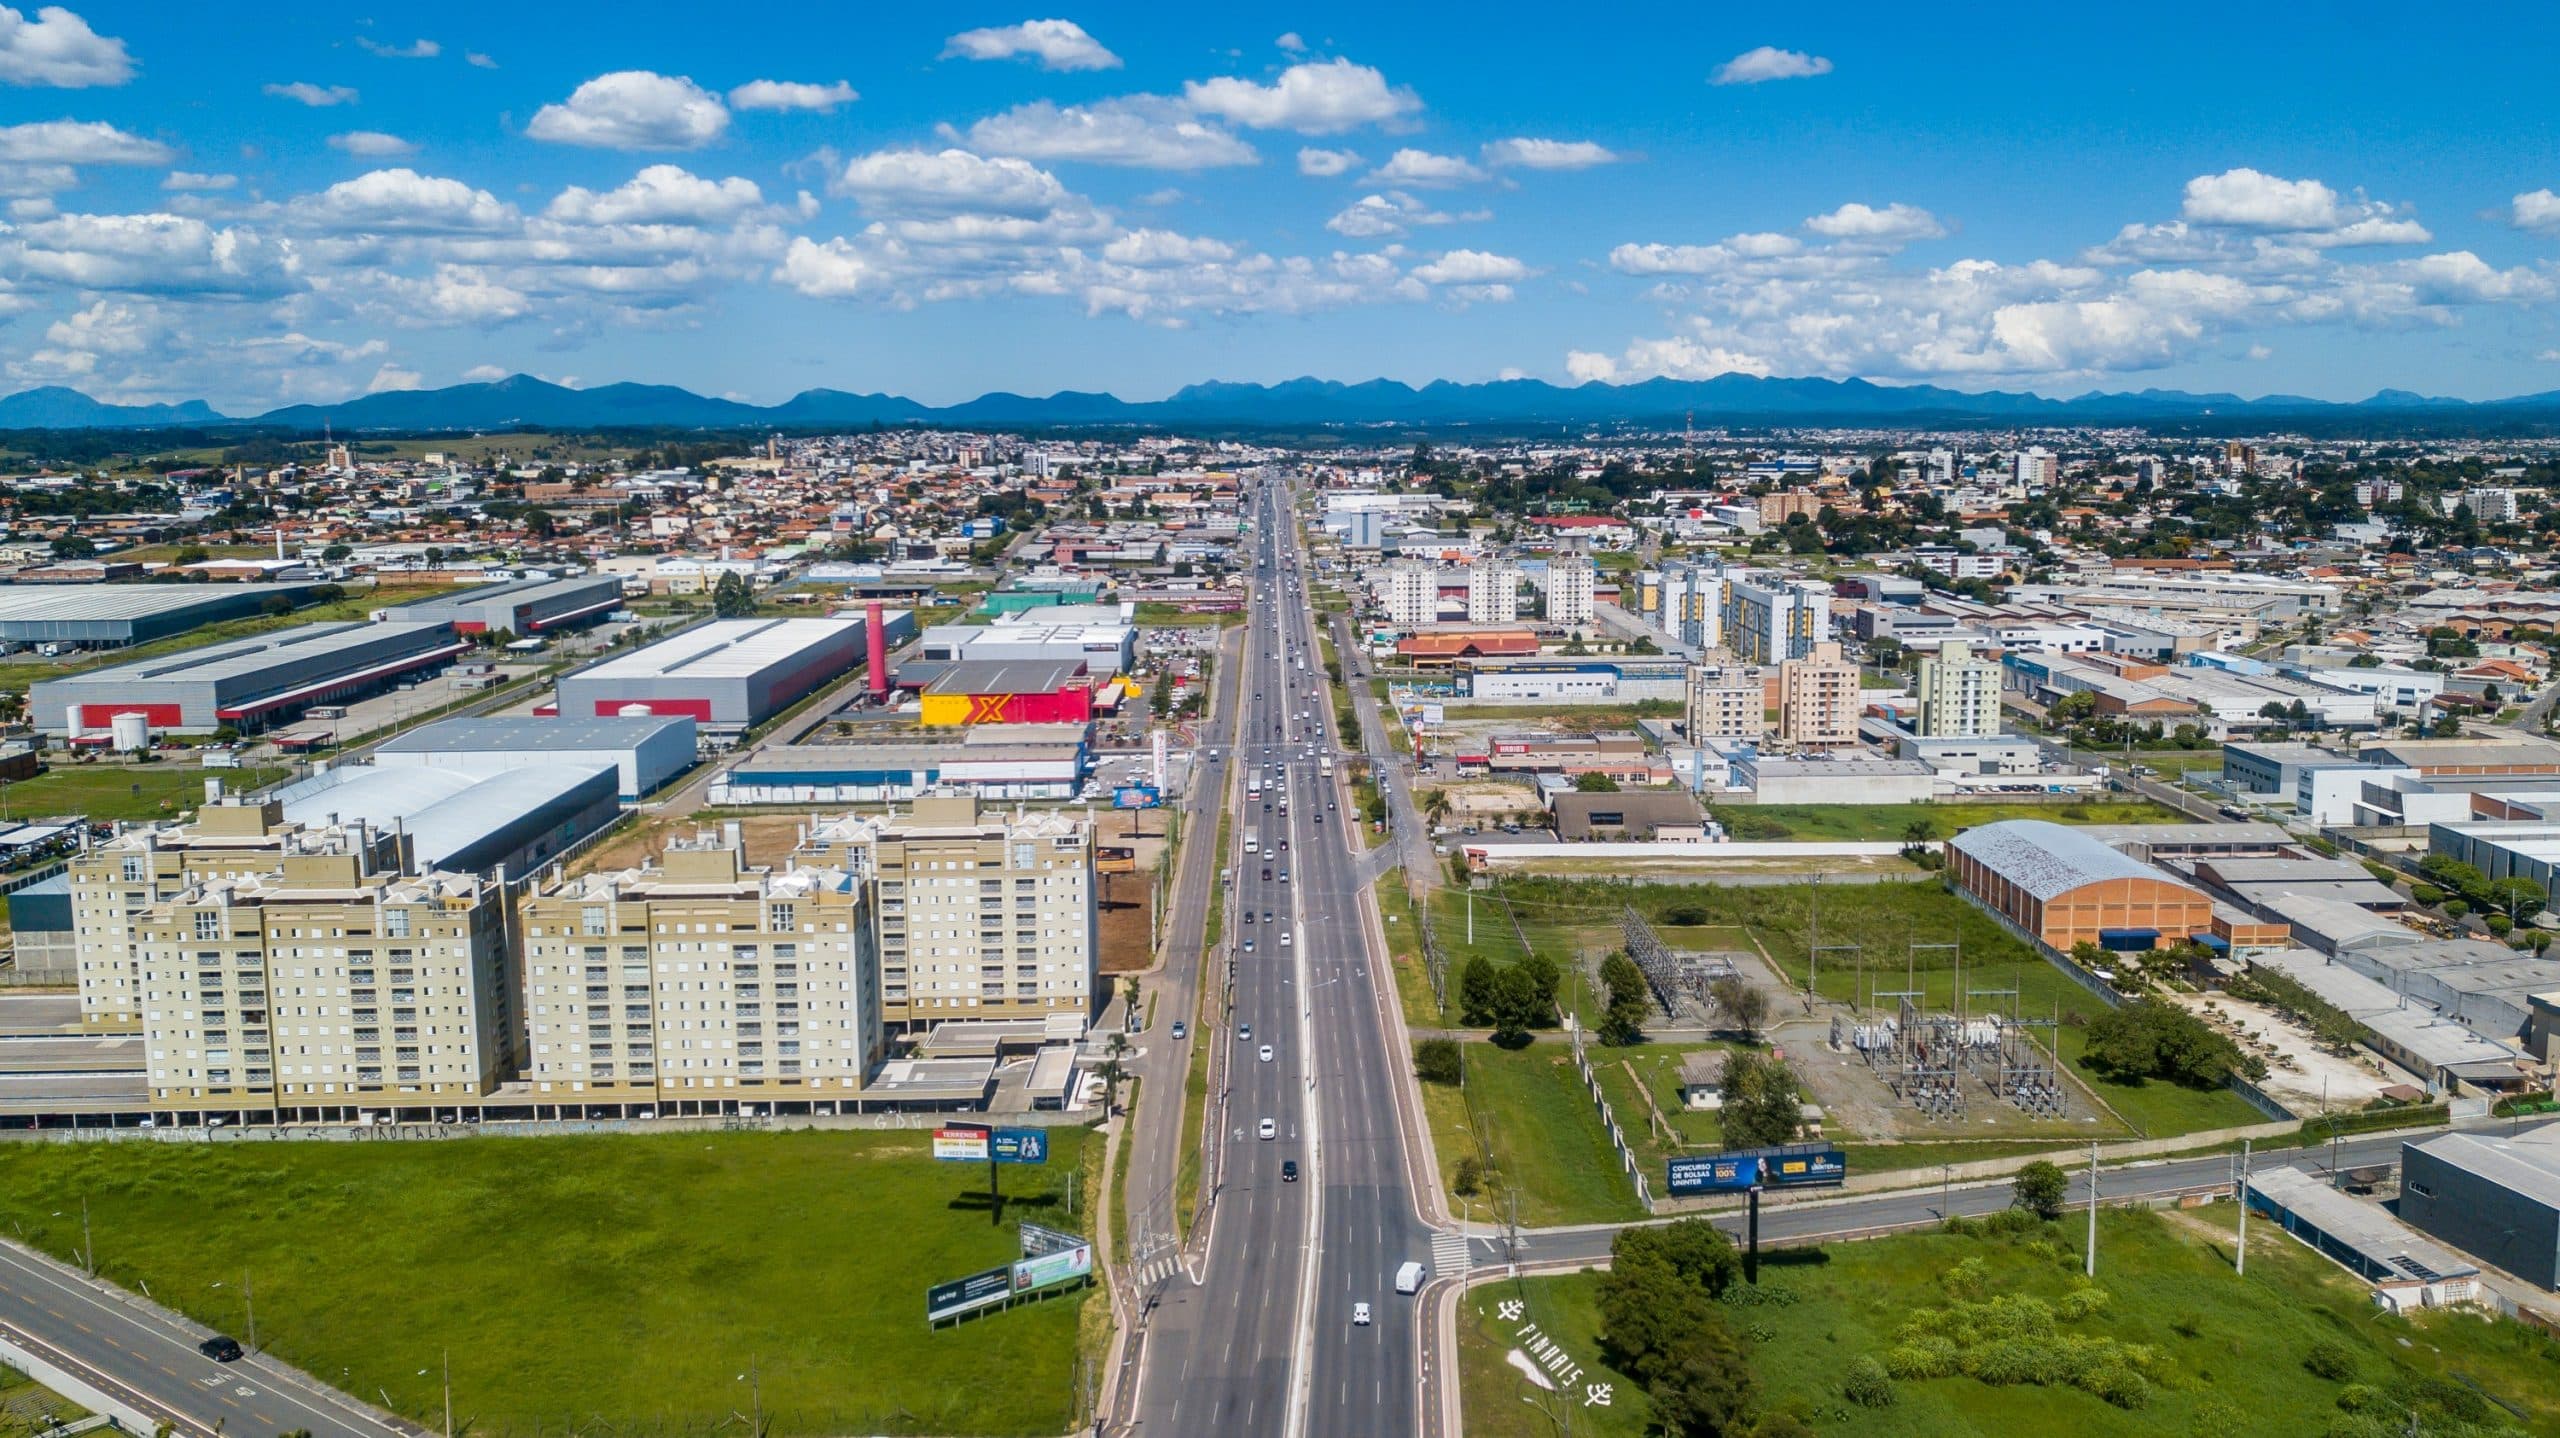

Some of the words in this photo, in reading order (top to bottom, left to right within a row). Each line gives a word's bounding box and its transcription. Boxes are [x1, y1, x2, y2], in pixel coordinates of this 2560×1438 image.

[1672, 1163, 1711, 1172] CONCURSO
[1672, 1172, 1683, 1180] DE
[1684, 1170, 1711, 1179] BOLSAS
[1715, 1168, 1736, 1178] 100%
[1672, 1178, 1702, 1187] UNINTER
[1516, 1323, 1584, 1387] PINHAIS
